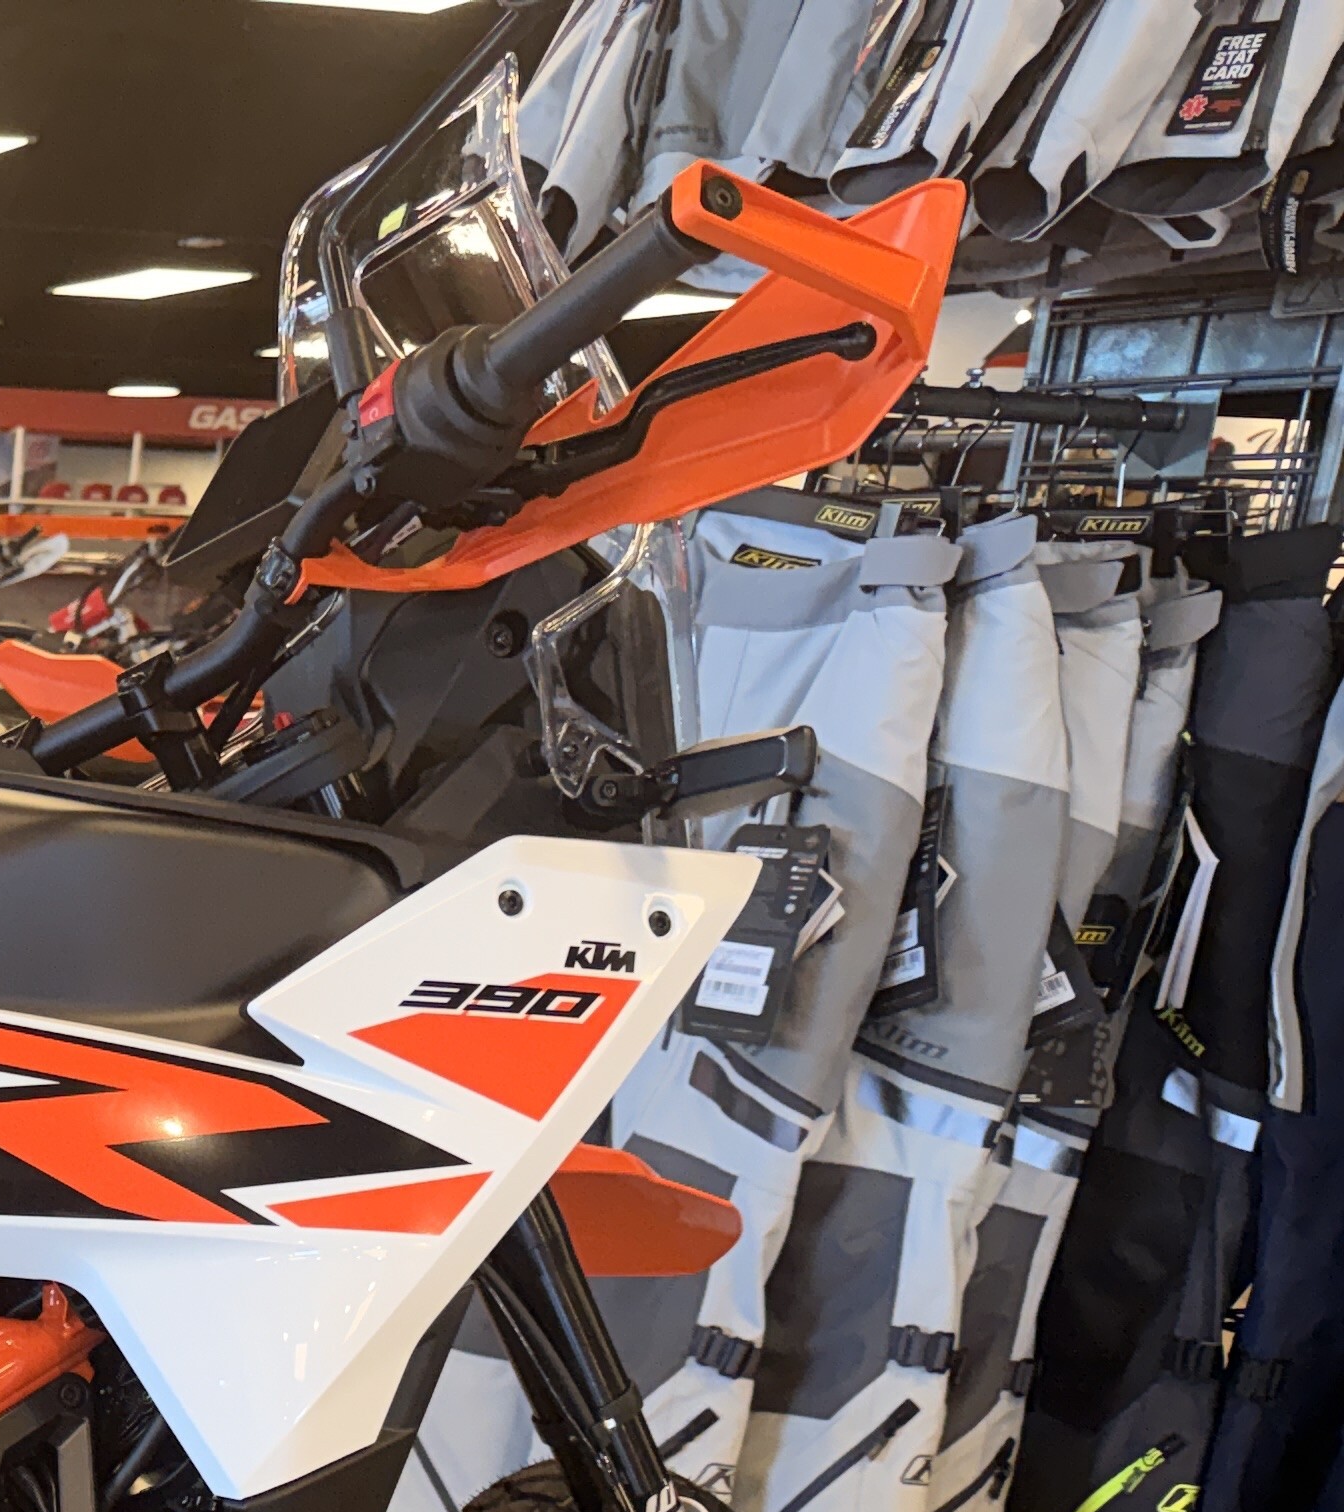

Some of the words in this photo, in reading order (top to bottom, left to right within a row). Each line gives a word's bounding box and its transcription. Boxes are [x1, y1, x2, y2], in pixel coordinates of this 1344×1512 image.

[1217, 33, 1267, 51] FREE
[1212, 49, 1259, 66] STAT
[1202, 63, 1254, 81] CARD
[820, 508, 868, 527] Klim
[1082, 517, 1142, 533] Klim
[564, 940, 636, 973] KTM
[398, 980, 604, 1022] 390
[1158, 1007, 1205, 1057] Klim
